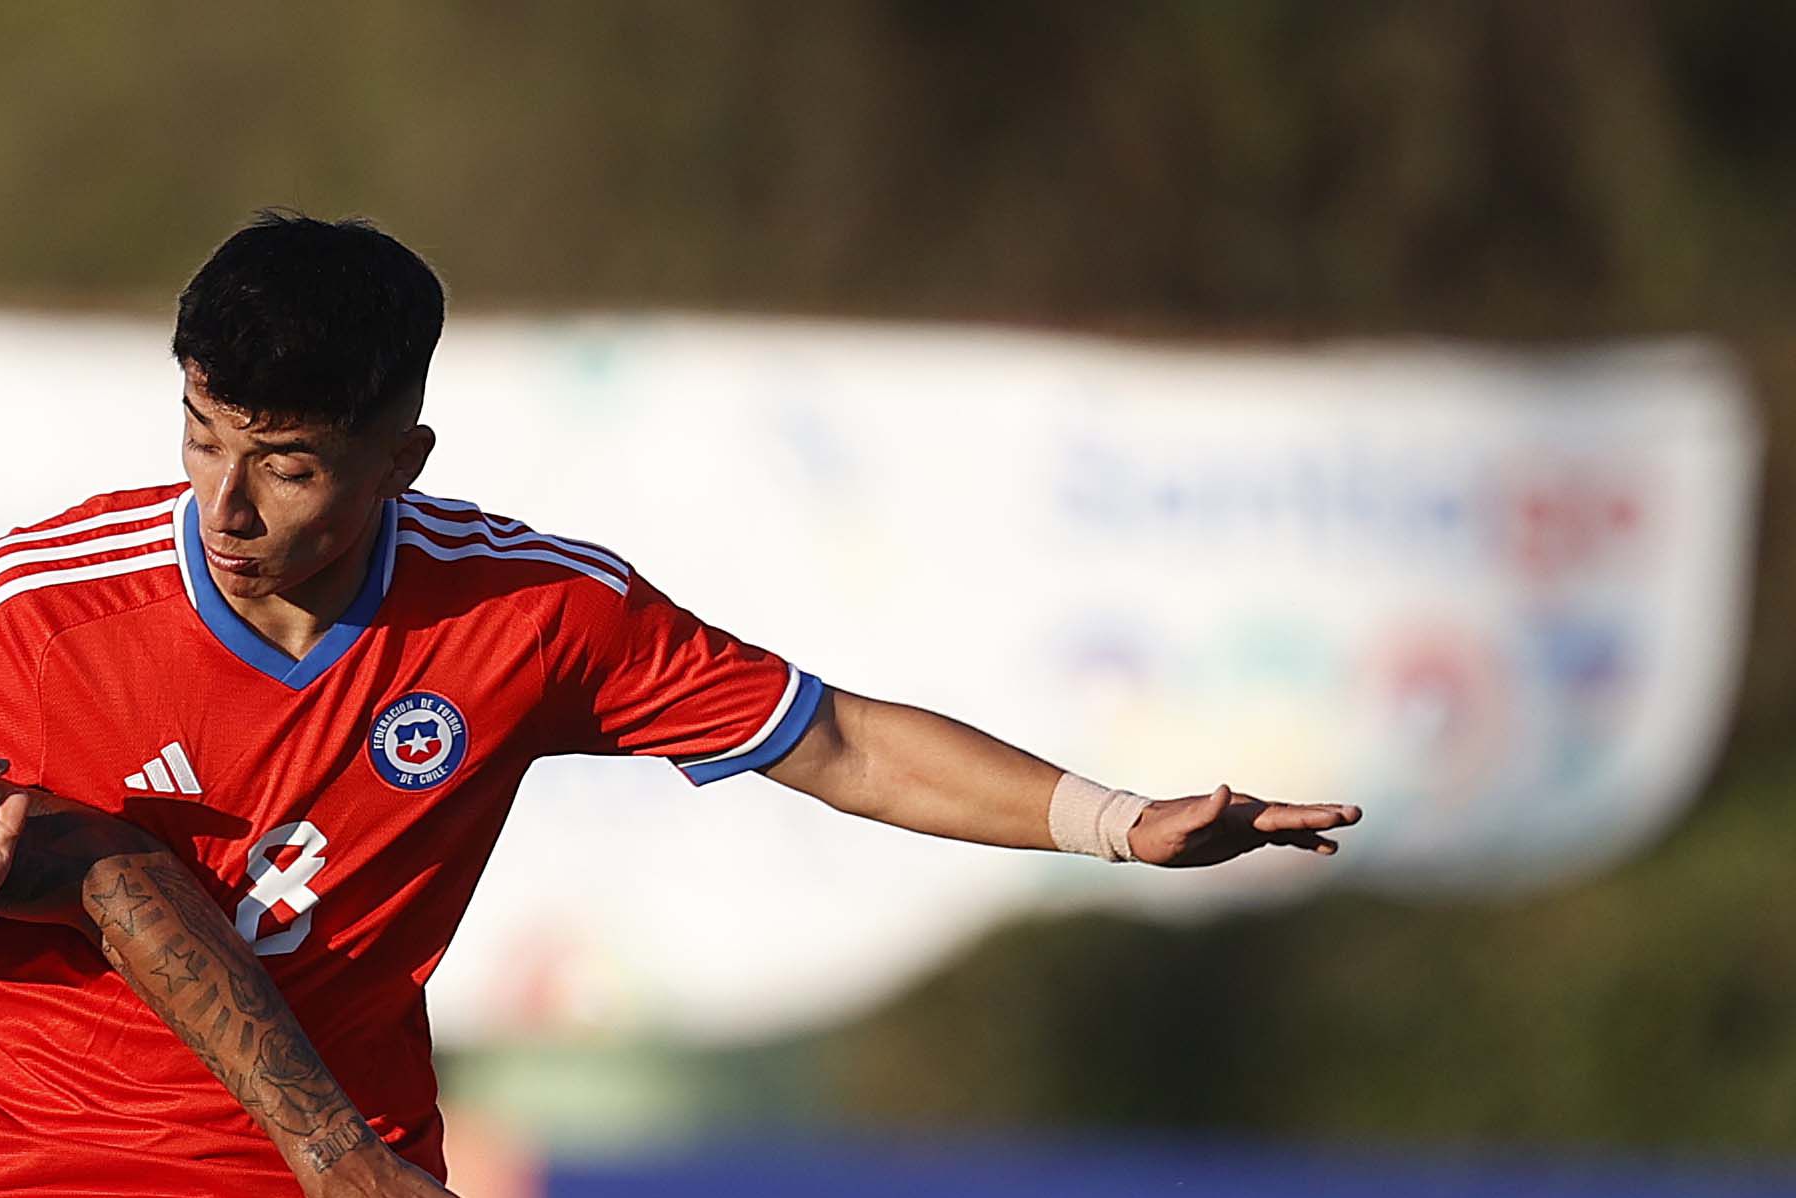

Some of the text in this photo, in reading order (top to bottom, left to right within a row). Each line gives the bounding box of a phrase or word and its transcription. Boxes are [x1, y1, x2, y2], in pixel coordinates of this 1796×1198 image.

[373, 698, 463, 749] FEDERACION DE FUTBOL
[400, 766, 447, 785] DE CHILE
[235, 821, 328, 956] 8
